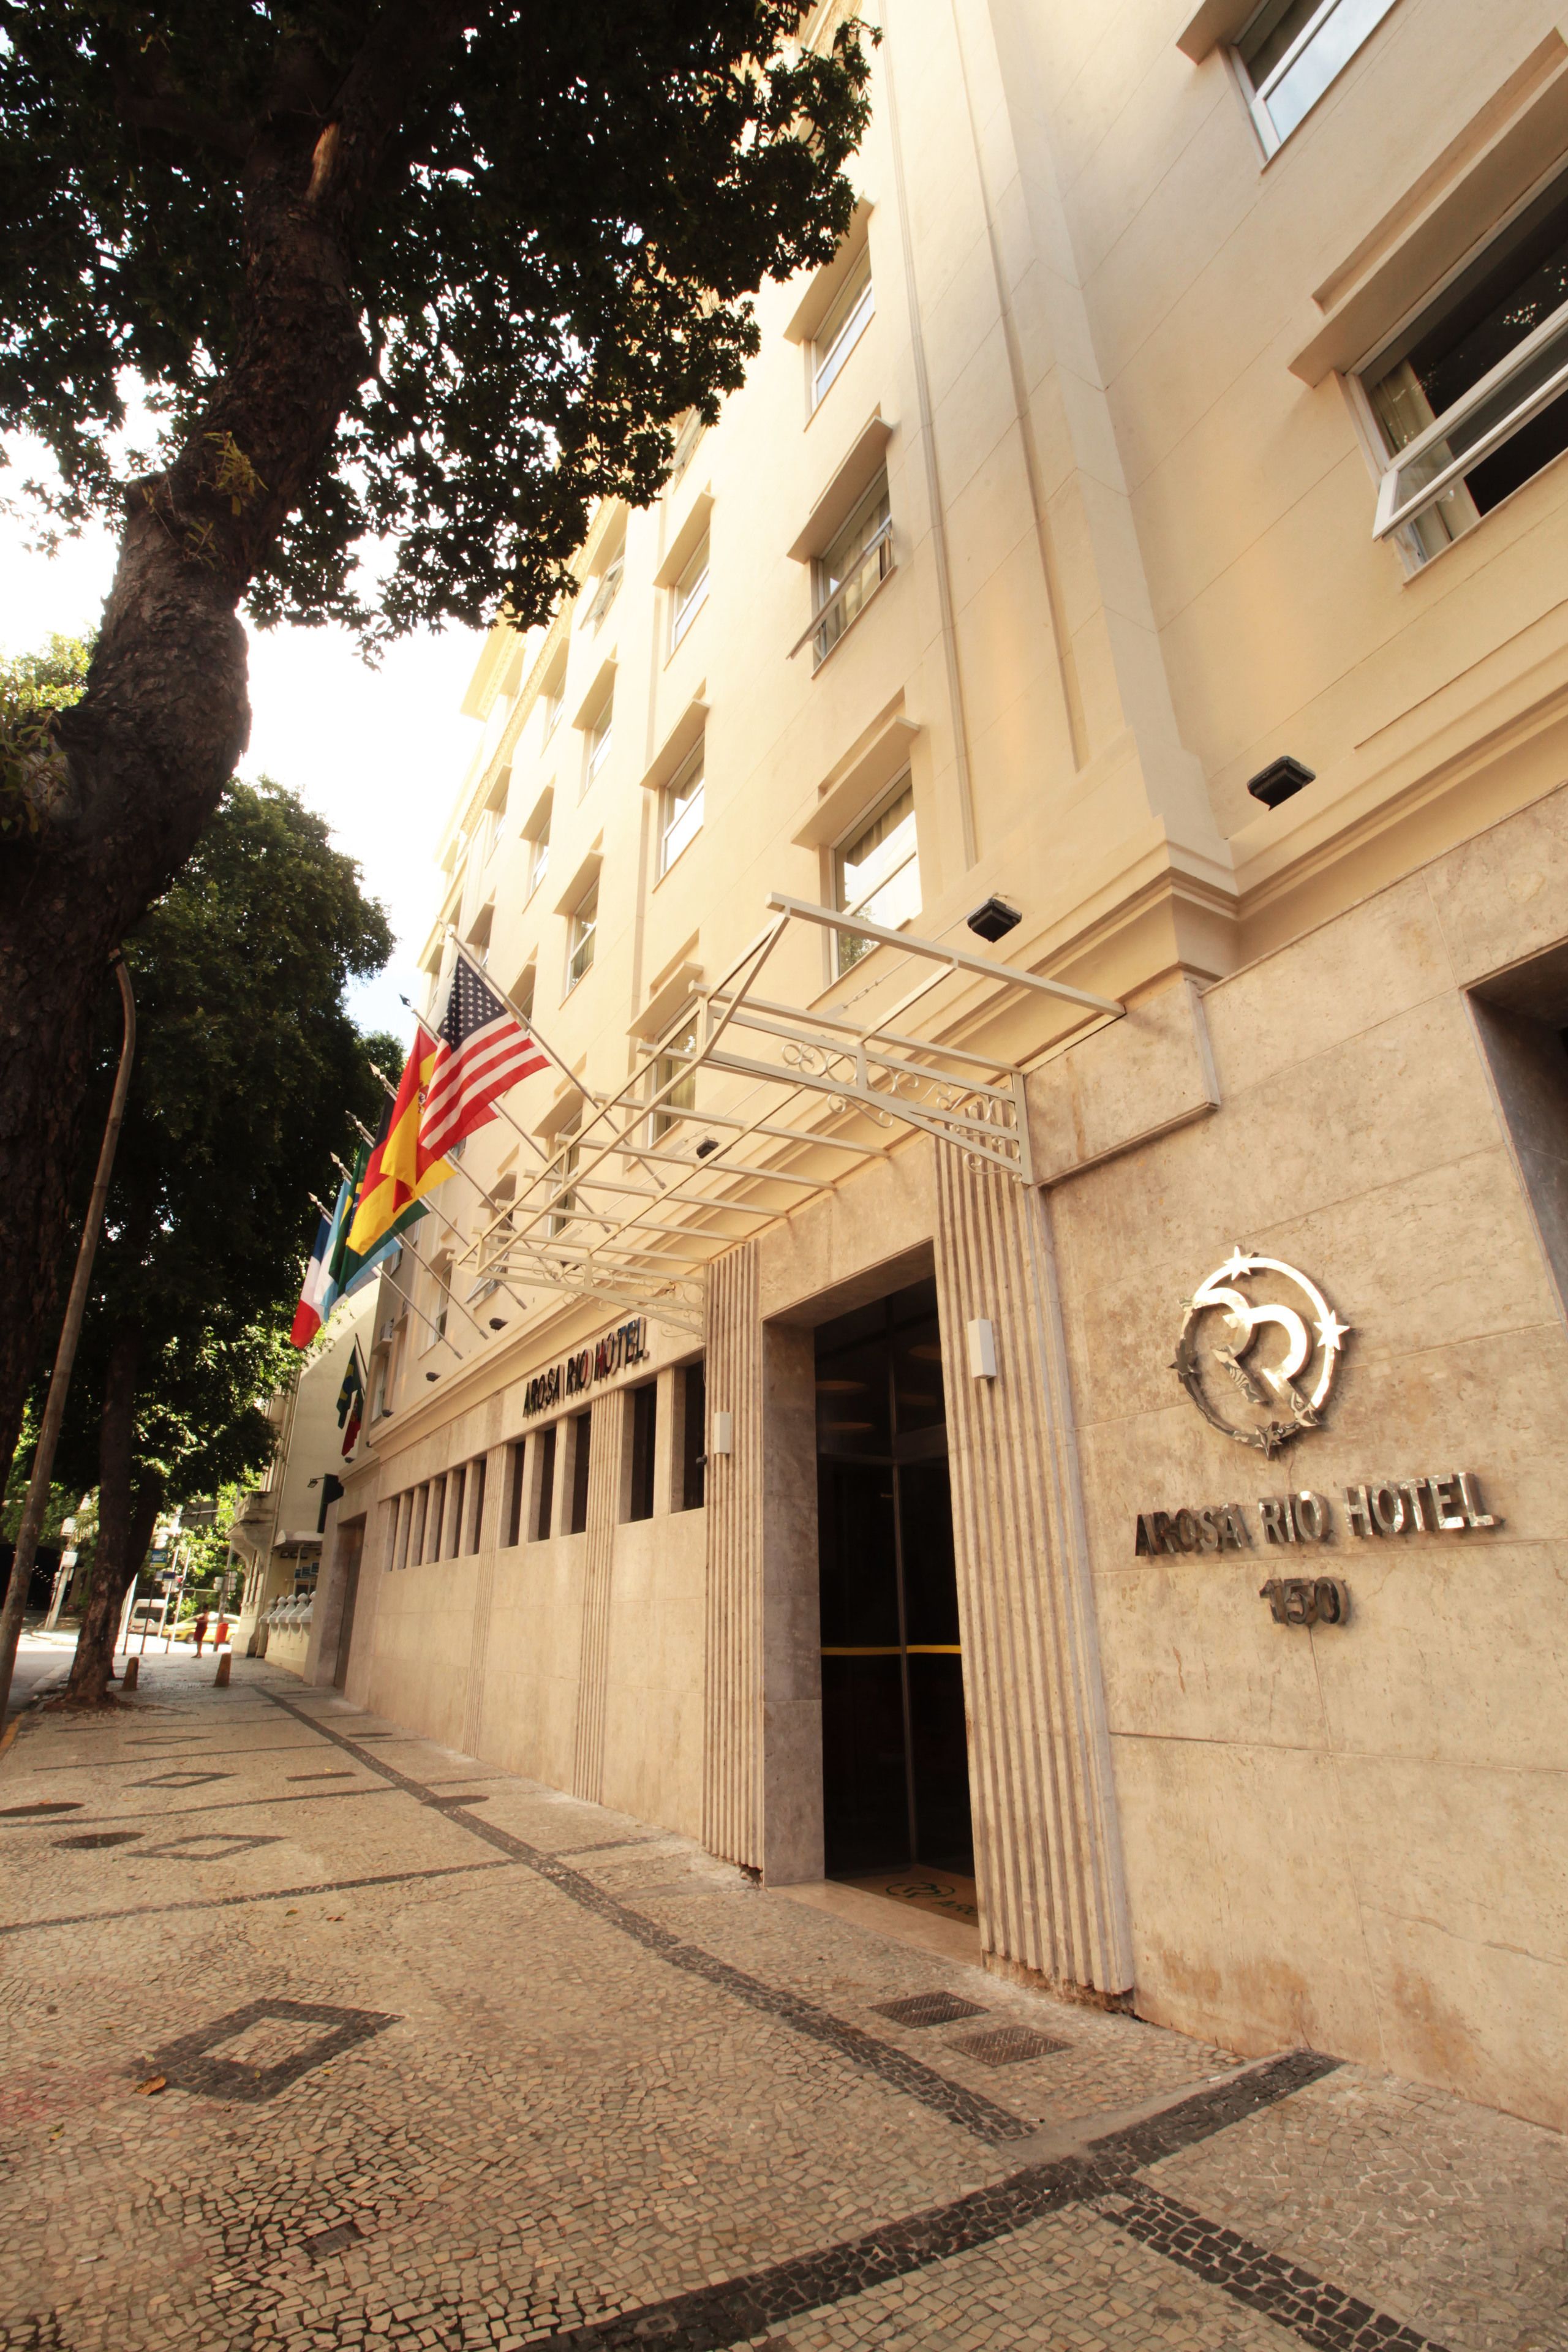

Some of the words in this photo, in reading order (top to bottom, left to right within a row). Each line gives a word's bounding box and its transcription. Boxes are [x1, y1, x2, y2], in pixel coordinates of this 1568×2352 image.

[522, 1364, 565, 1418] AROSA
[566, 1349, 594, 1396] RIO
[594, 1317, 649, 1382] HOTEL
[1135, 1503, 1253, 1556] AROSA
[1258, 1490, 1332, 1544] RIO
[1343, 1472, 1503, 1537] HOTEL
[1259, 1577, 1349, 1624] 150
